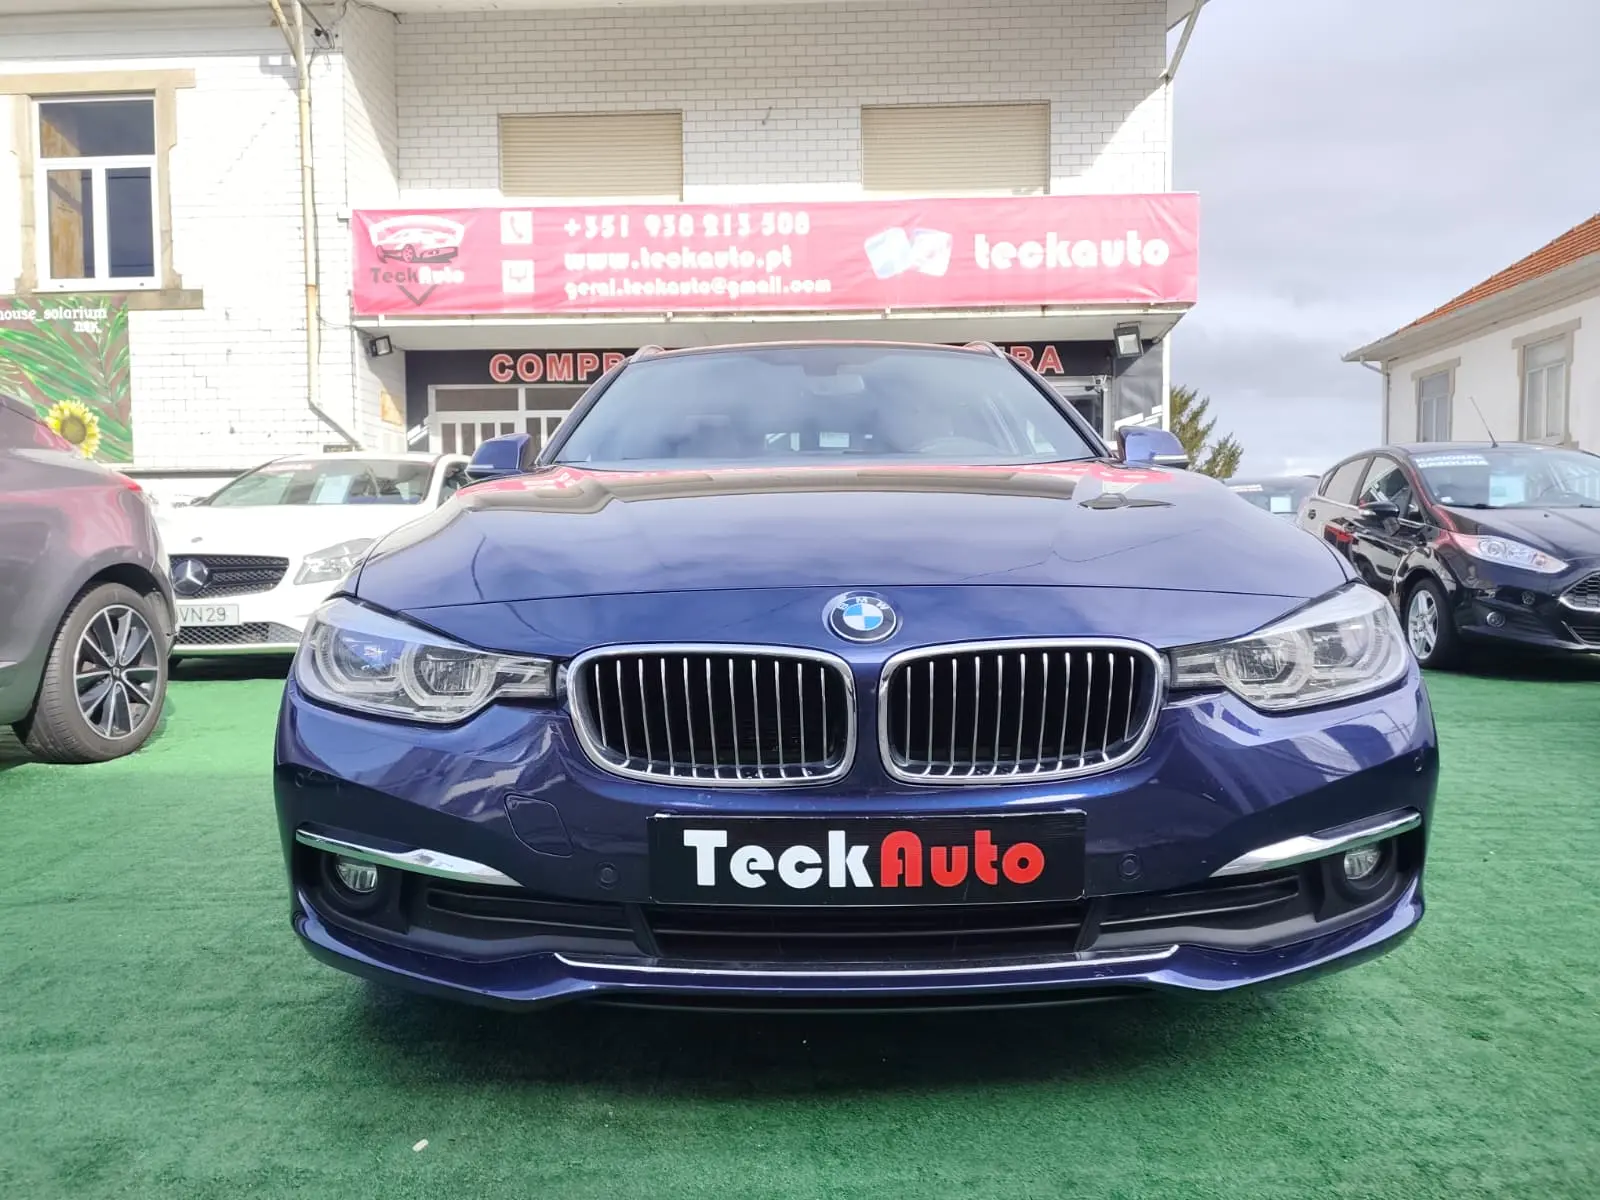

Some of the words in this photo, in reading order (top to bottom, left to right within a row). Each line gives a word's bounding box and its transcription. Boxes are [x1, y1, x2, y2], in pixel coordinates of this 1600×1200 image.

[564, 244, 793, 272] www.teckauto.pt
[973, 230, 1170, 270] teckauto
[370, 266, 465, 285] TeckAuto
[1000, 345, 1065, 374] RA
[206, 606, 226, 623] 29
[683, 829, 1046, 889] TeckAuto
